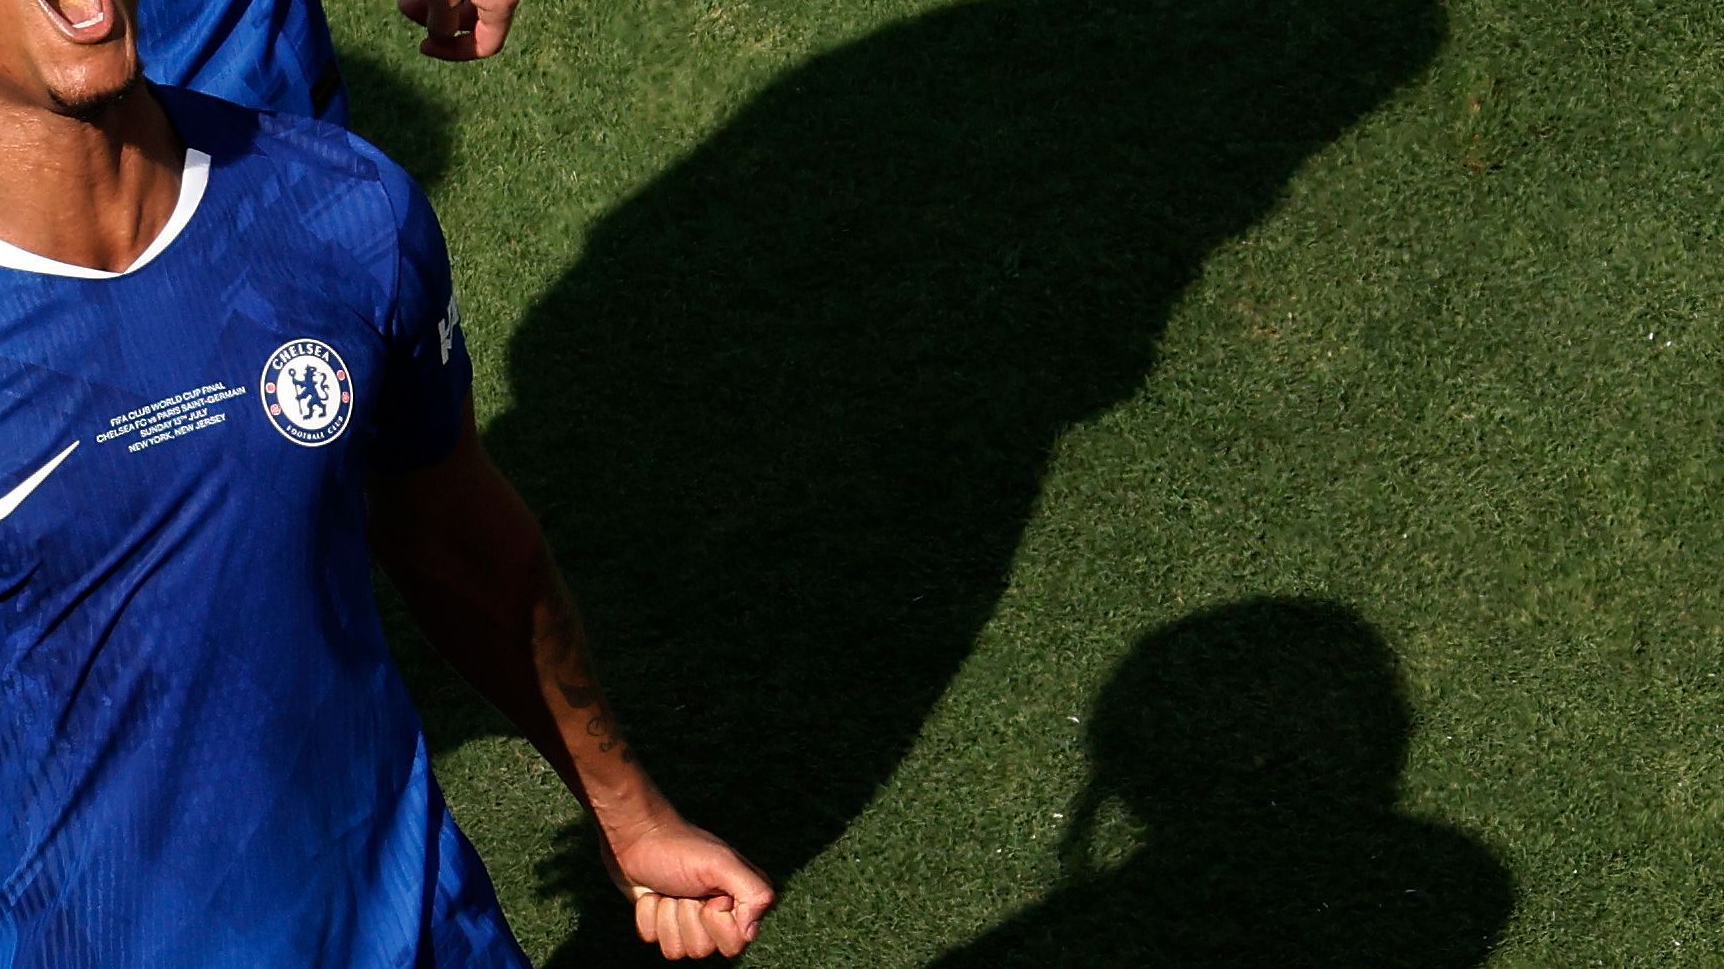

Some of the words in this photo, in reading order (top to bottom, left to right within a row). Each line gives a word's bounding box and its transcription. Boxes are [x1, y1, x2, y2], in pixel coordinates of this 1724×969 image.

[272, 343, 330, 370] CHELSEA
[96, 425, 136, 443] CHELSEA
[135, 418, 148, 429] FC
[156, 407, 181, 421] PARIS
[181, 386, 246, 412] SAINT-GERMAIN
[110, 415, 128, 427] FIFA
[128, 407, 151, 420] CLUB
[151, 396, 183, 412] WORLD
[183, 389, 201, 401] CUP
[202, 382, 225, 395] FINAL
[128, 440, 149, 453] NEW
[174, 425, 195, 437] NEW
[195, 413, 226, 431] JERSEY
[140, 422, 173, 438] SUNDAY
[188, 408, 208, 421] JULY
[286, 424, 325, 440] FOOTBALL
[327, 415, 344, 434] CLUB
